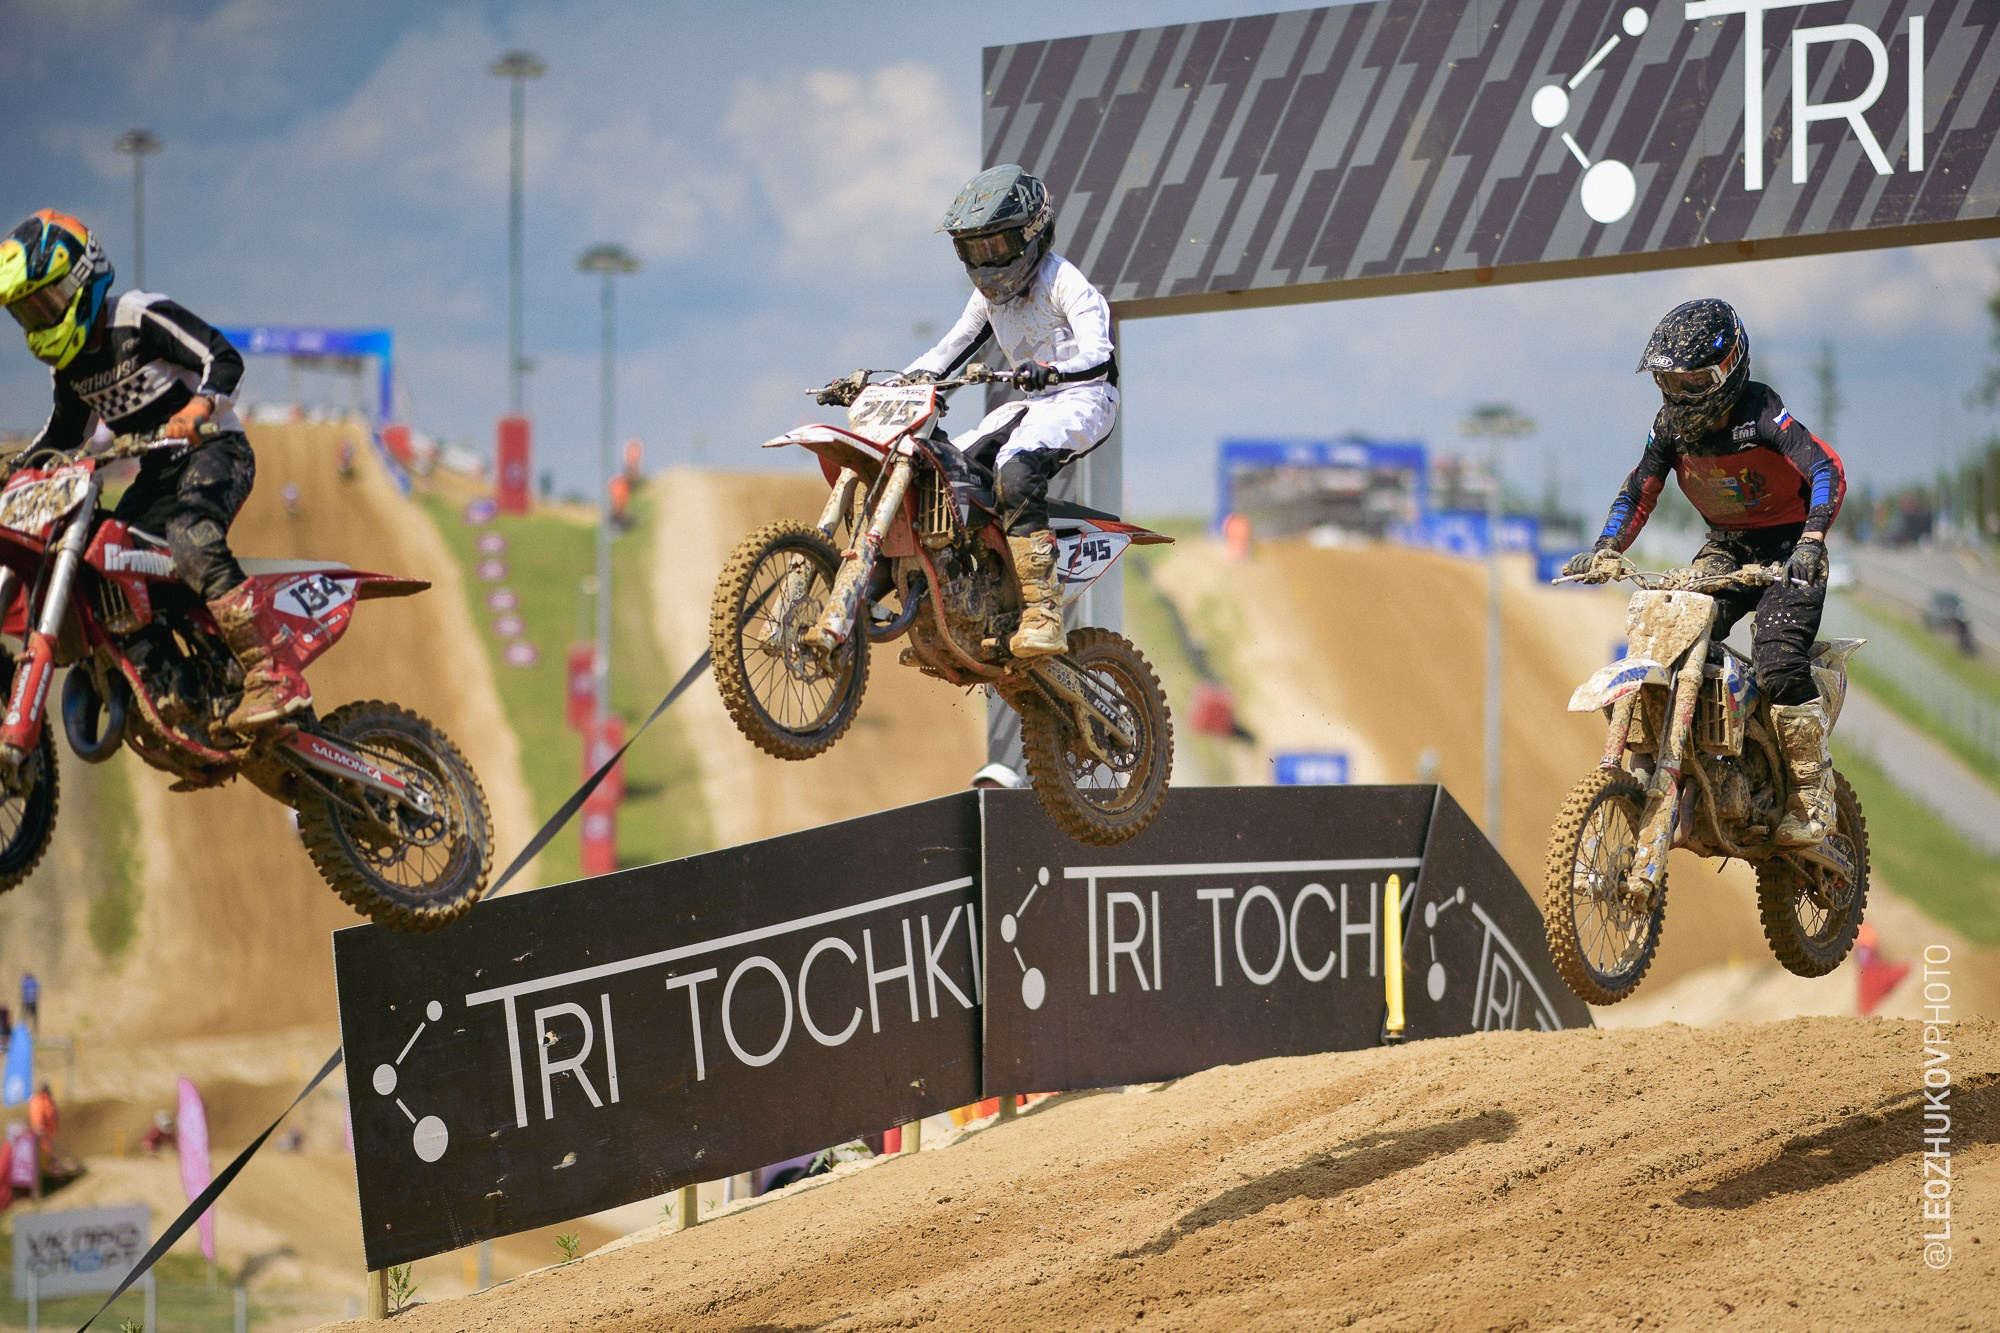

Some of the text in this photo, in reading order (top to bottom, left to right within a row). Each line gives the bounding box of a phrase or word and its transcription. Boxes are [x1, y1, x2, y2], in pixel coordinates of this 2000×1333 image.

[1685, 0, 1924, 190] TRI
[854, 400, 926, 427] 245
[1068, 538, 1111, 569] 245
[289, 575, 346, 616] 134
[312, 743, 382, 781] SALMONICA
[1064, 864, 1161, 995] TRI
[466, 903, 983, 1128] TRI TOCHKI
